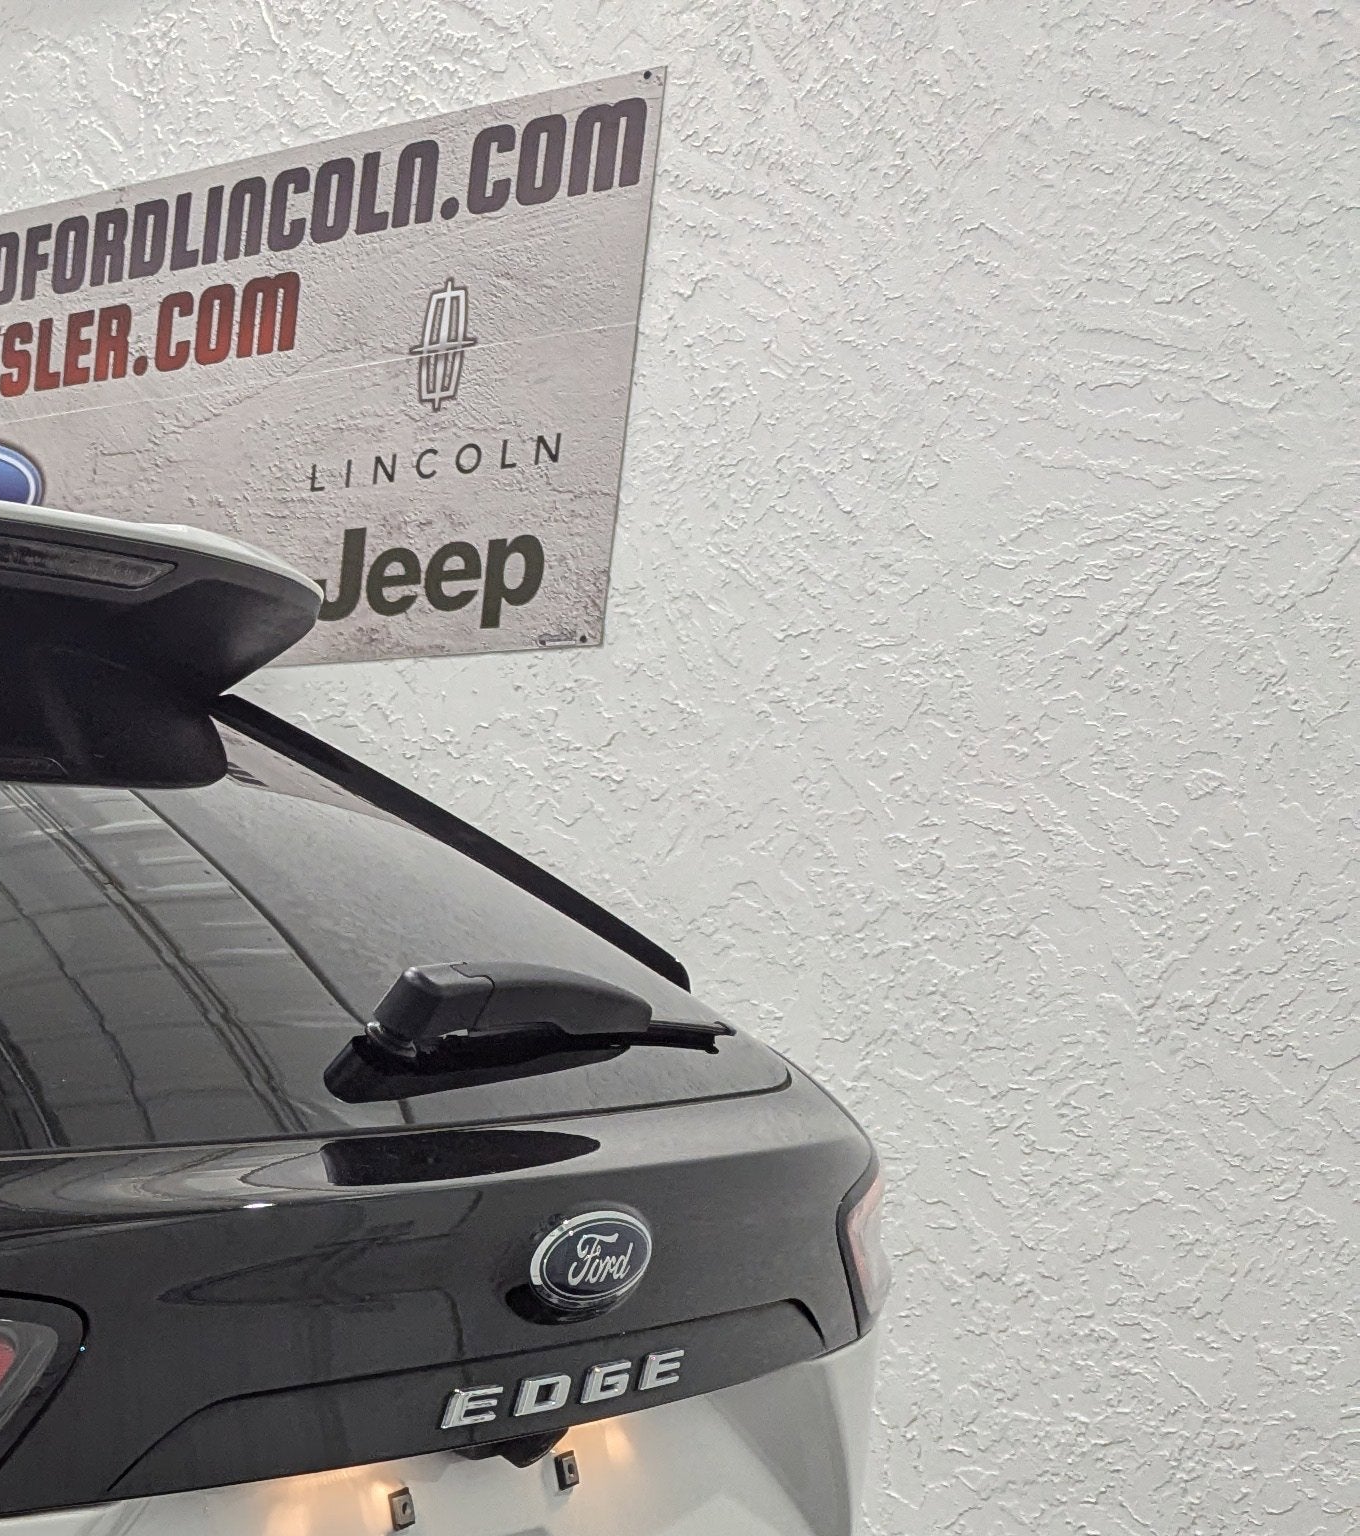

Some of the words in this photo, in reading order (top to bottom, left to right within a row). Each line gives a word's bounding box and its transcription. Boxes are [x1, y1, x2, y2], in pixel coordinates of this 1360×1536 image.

[309, 432, 562, 492] LINCOLN
[313, 527, 545, 629] Jeep
[568, 1232, 632, 1287] Ford
[440, 1349, 686, 1430] EDGE
